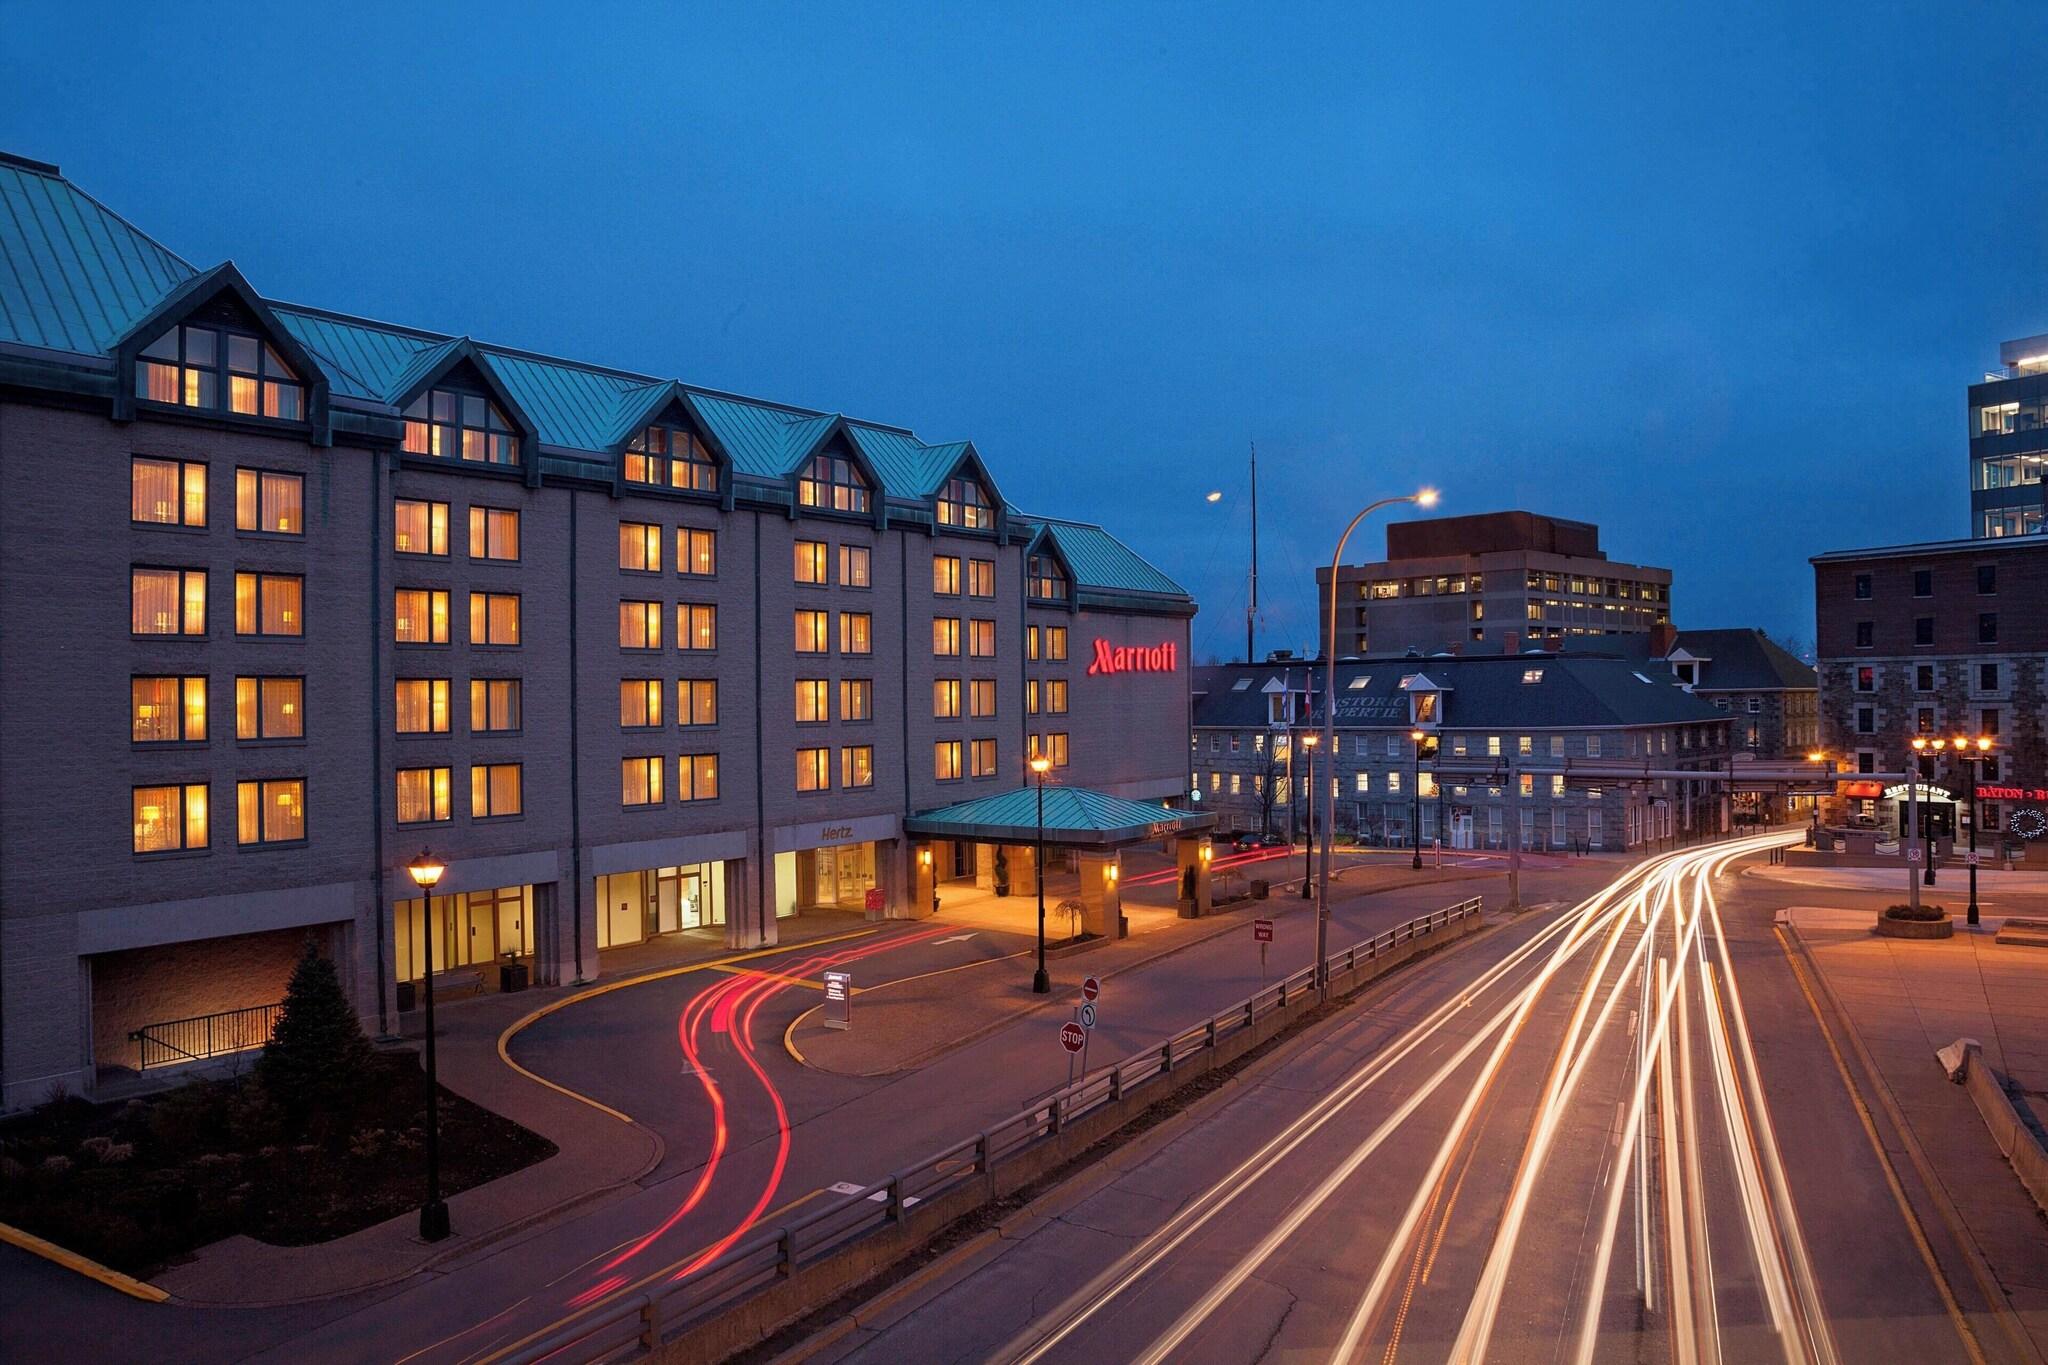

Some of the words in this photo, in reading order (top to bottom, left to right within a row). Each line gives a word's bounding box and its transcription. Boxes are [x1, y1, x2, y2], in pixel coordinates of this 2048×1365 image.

[1089, 638, 1177, 675] Marriott
[1321, 697, 1407, 708] ISTORIC
[1884, 784, 1951, 798] RESTURANT
[1152, 820, 1181, 834] Marriott
[1062, 1030, 1084, 1045] STOP
